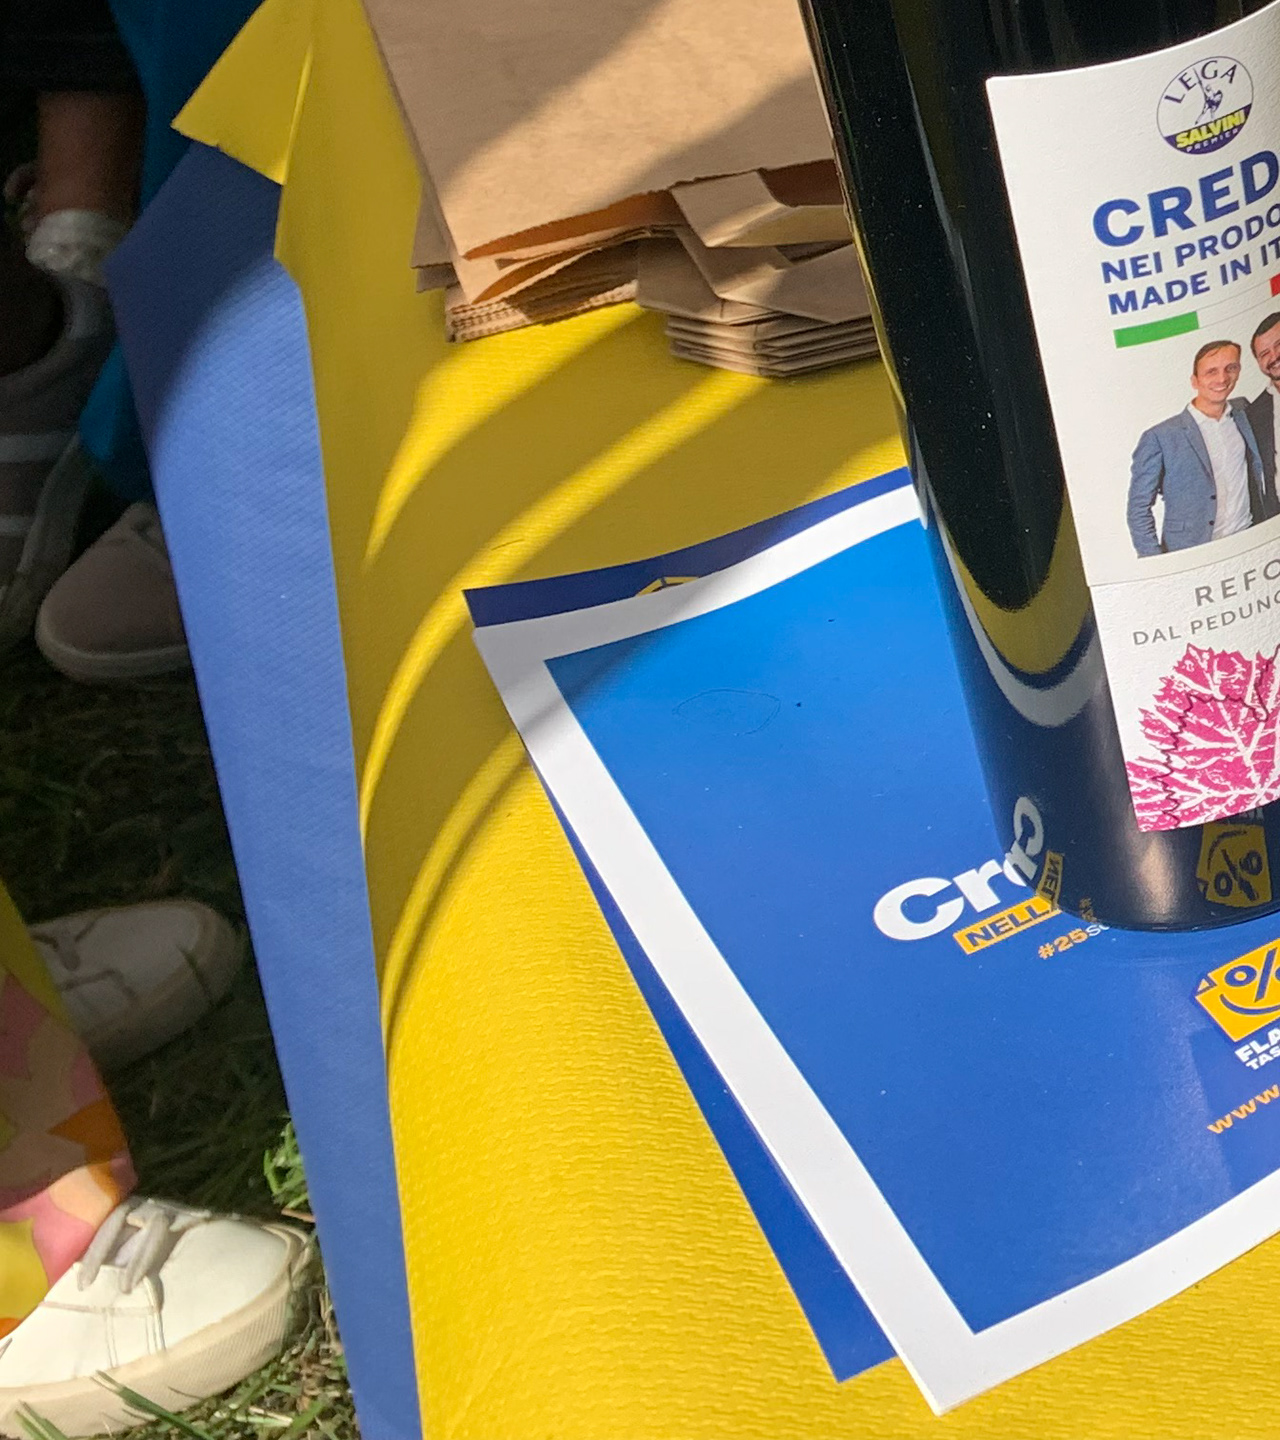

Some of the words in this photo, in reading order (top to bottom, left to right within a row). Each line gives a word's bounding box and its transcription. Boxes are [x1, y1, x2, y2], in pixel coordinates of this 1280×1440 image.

[1164, 59, 1238, 105] LEGA
[1175, 108, 1246, 149] SALVINI
[1101, 251, 1163, 284] NEI
[1108, 271, 1210, 315] MADE
[1219, 254, 1252, 286] IN
[1132, 627, 1182, 646] DAL
